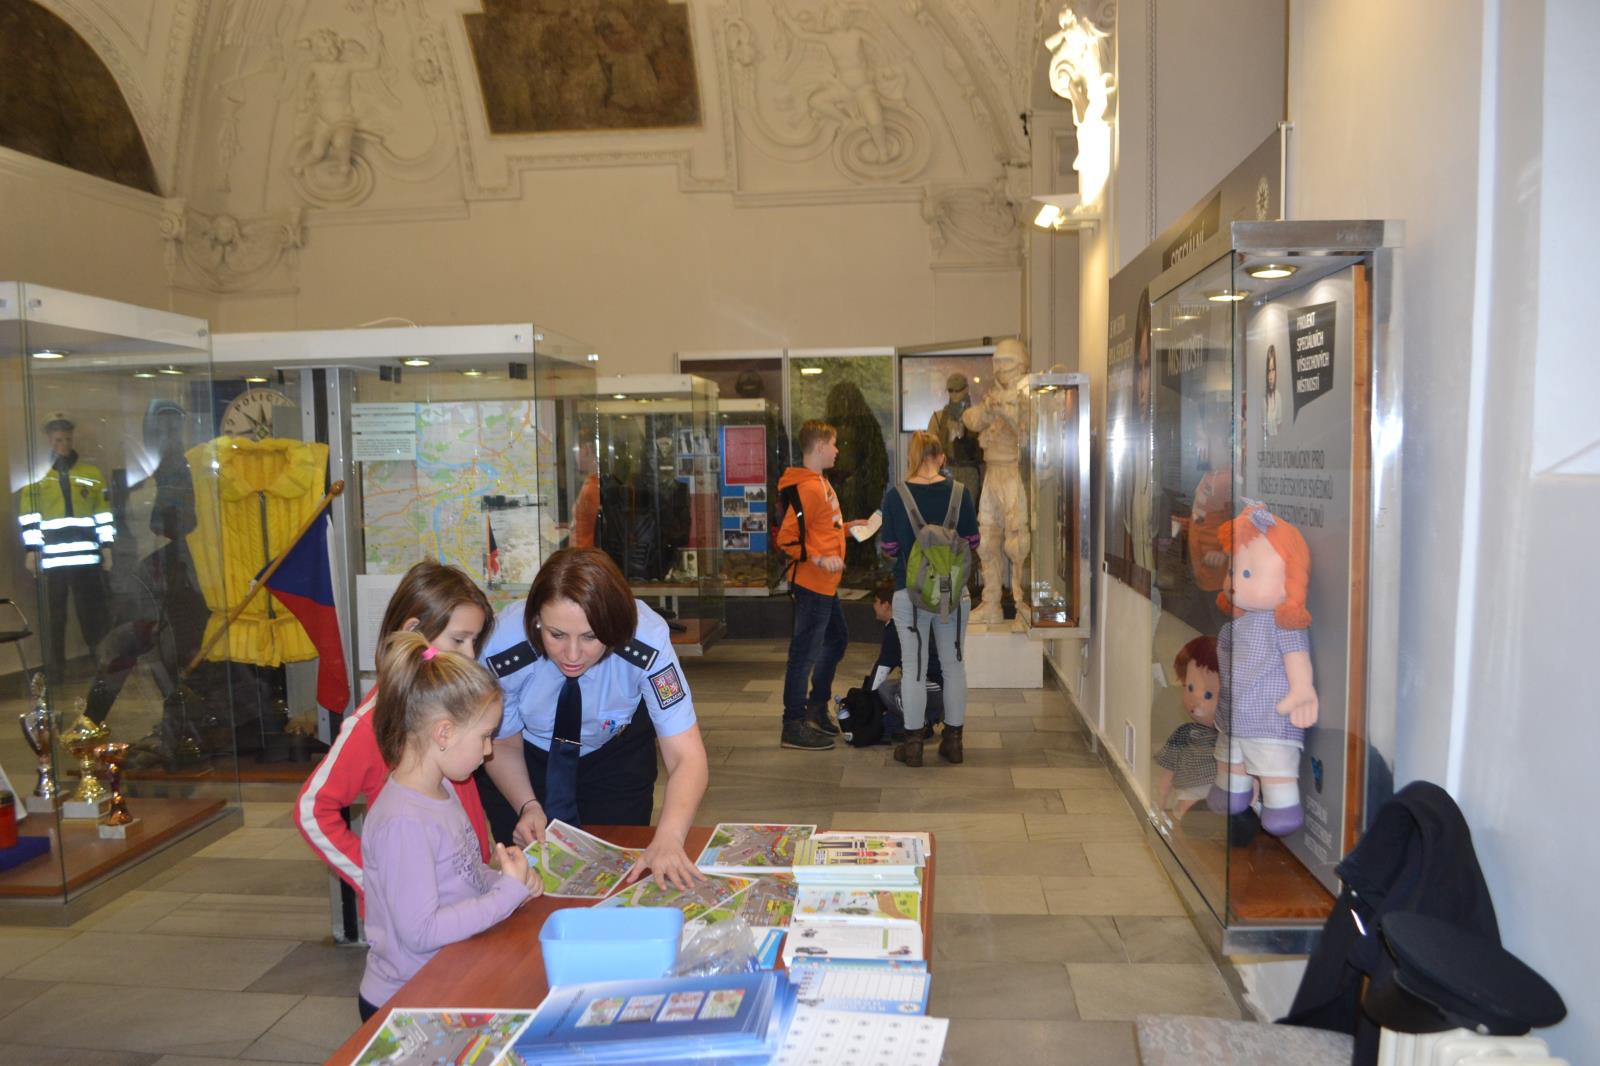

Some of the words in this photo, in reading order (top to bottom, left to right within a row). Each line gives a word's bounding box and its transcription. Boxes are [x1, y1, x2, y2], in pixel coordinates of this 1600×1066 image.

[1296, 311, 1316, 331] PROJEKT
[1296, 330, 1324, 352] SPECIÁLNÍCH
[1296, 350, 1330, 373] VÝSLECHOVÝCH
[1311, 450, 1325, 470] PRO
